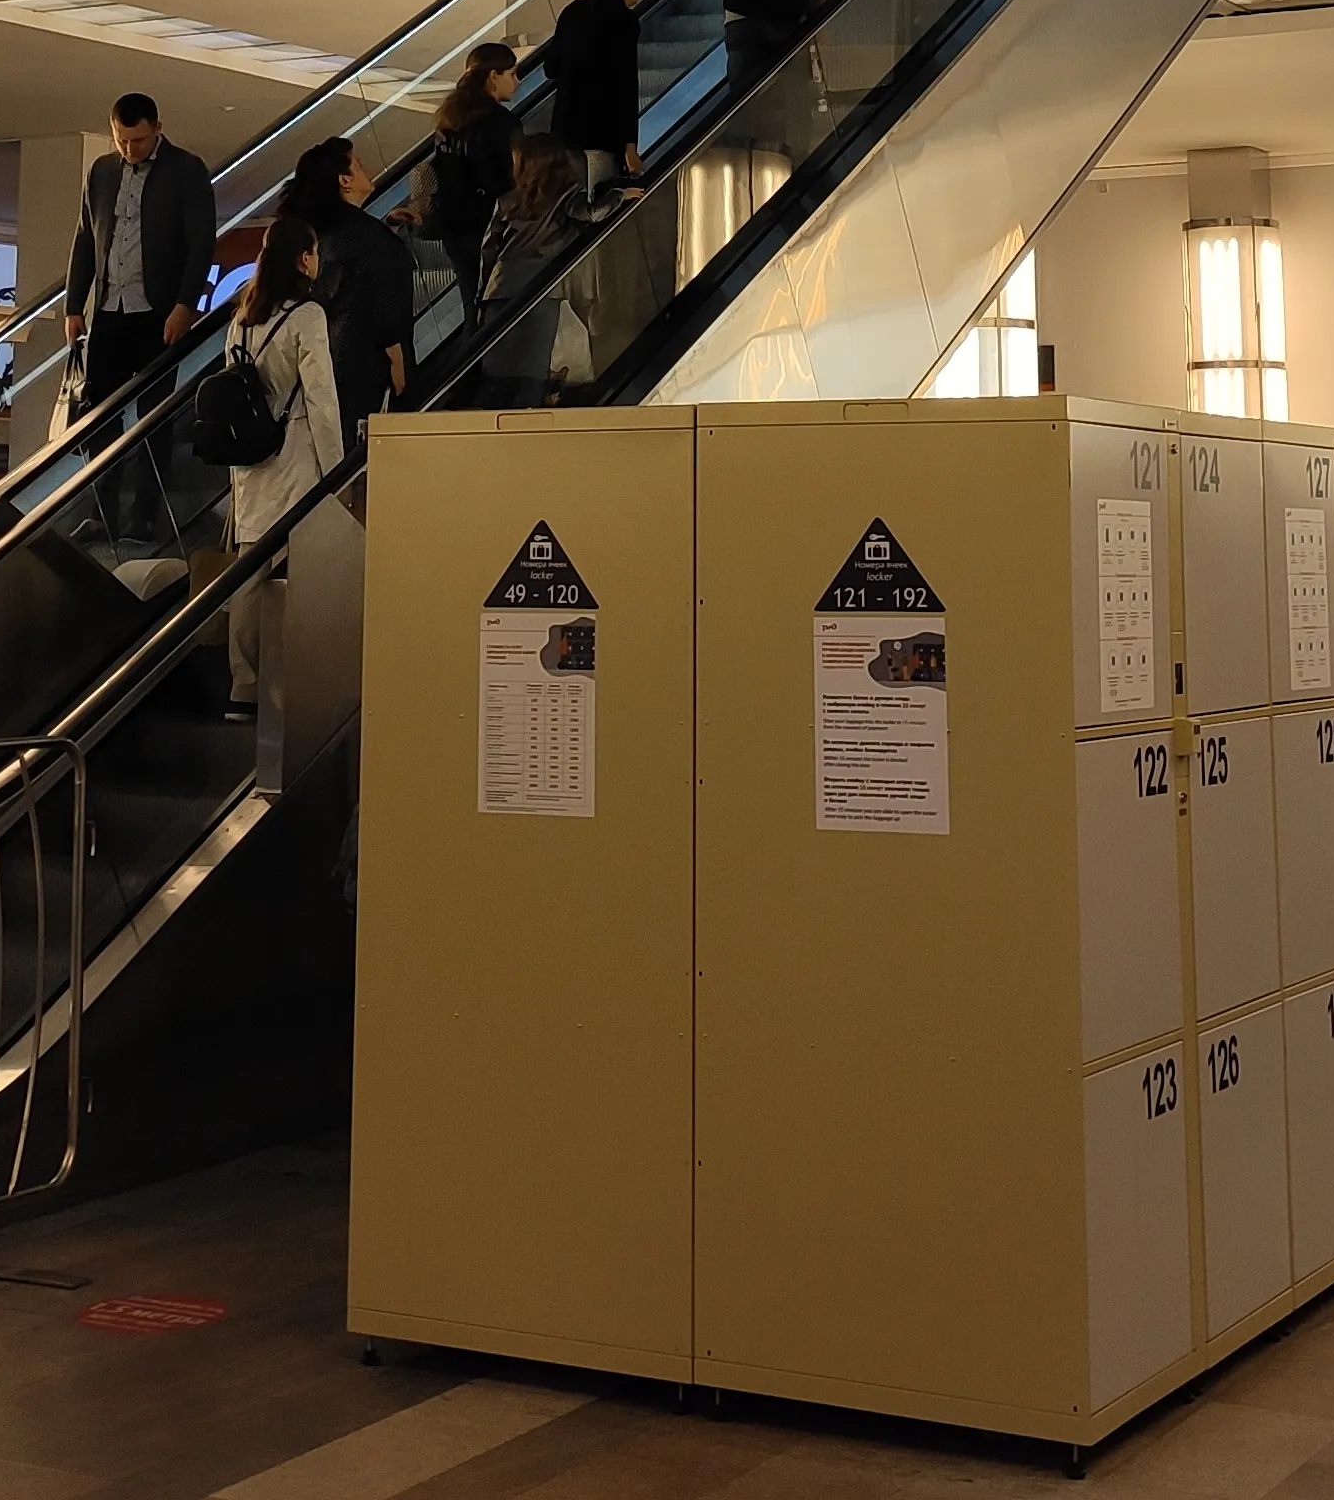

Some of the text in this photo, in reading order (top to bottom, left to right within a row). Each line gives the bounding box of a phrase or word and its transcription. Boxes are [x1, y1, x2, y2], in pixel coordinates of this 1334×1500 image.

[1129, 440, 1162, 491] 121
[1188, 444, 1221, 494] 124
[1306, 455, 1331, 499] 127
[854, 561, 885, 570] Номера
[866, 572, 894, 581] locker
[504, 584, 526, 604] 49
[546, 584, 579, 604] 120
[833, 587, 866, 608] 121
[892, 587, 928, 608] 192
[1133, 744, 1169, 798] 122
[1207, 1034, 1239, 1094] 126
[1142, 1057, 1178, 1120] 123
